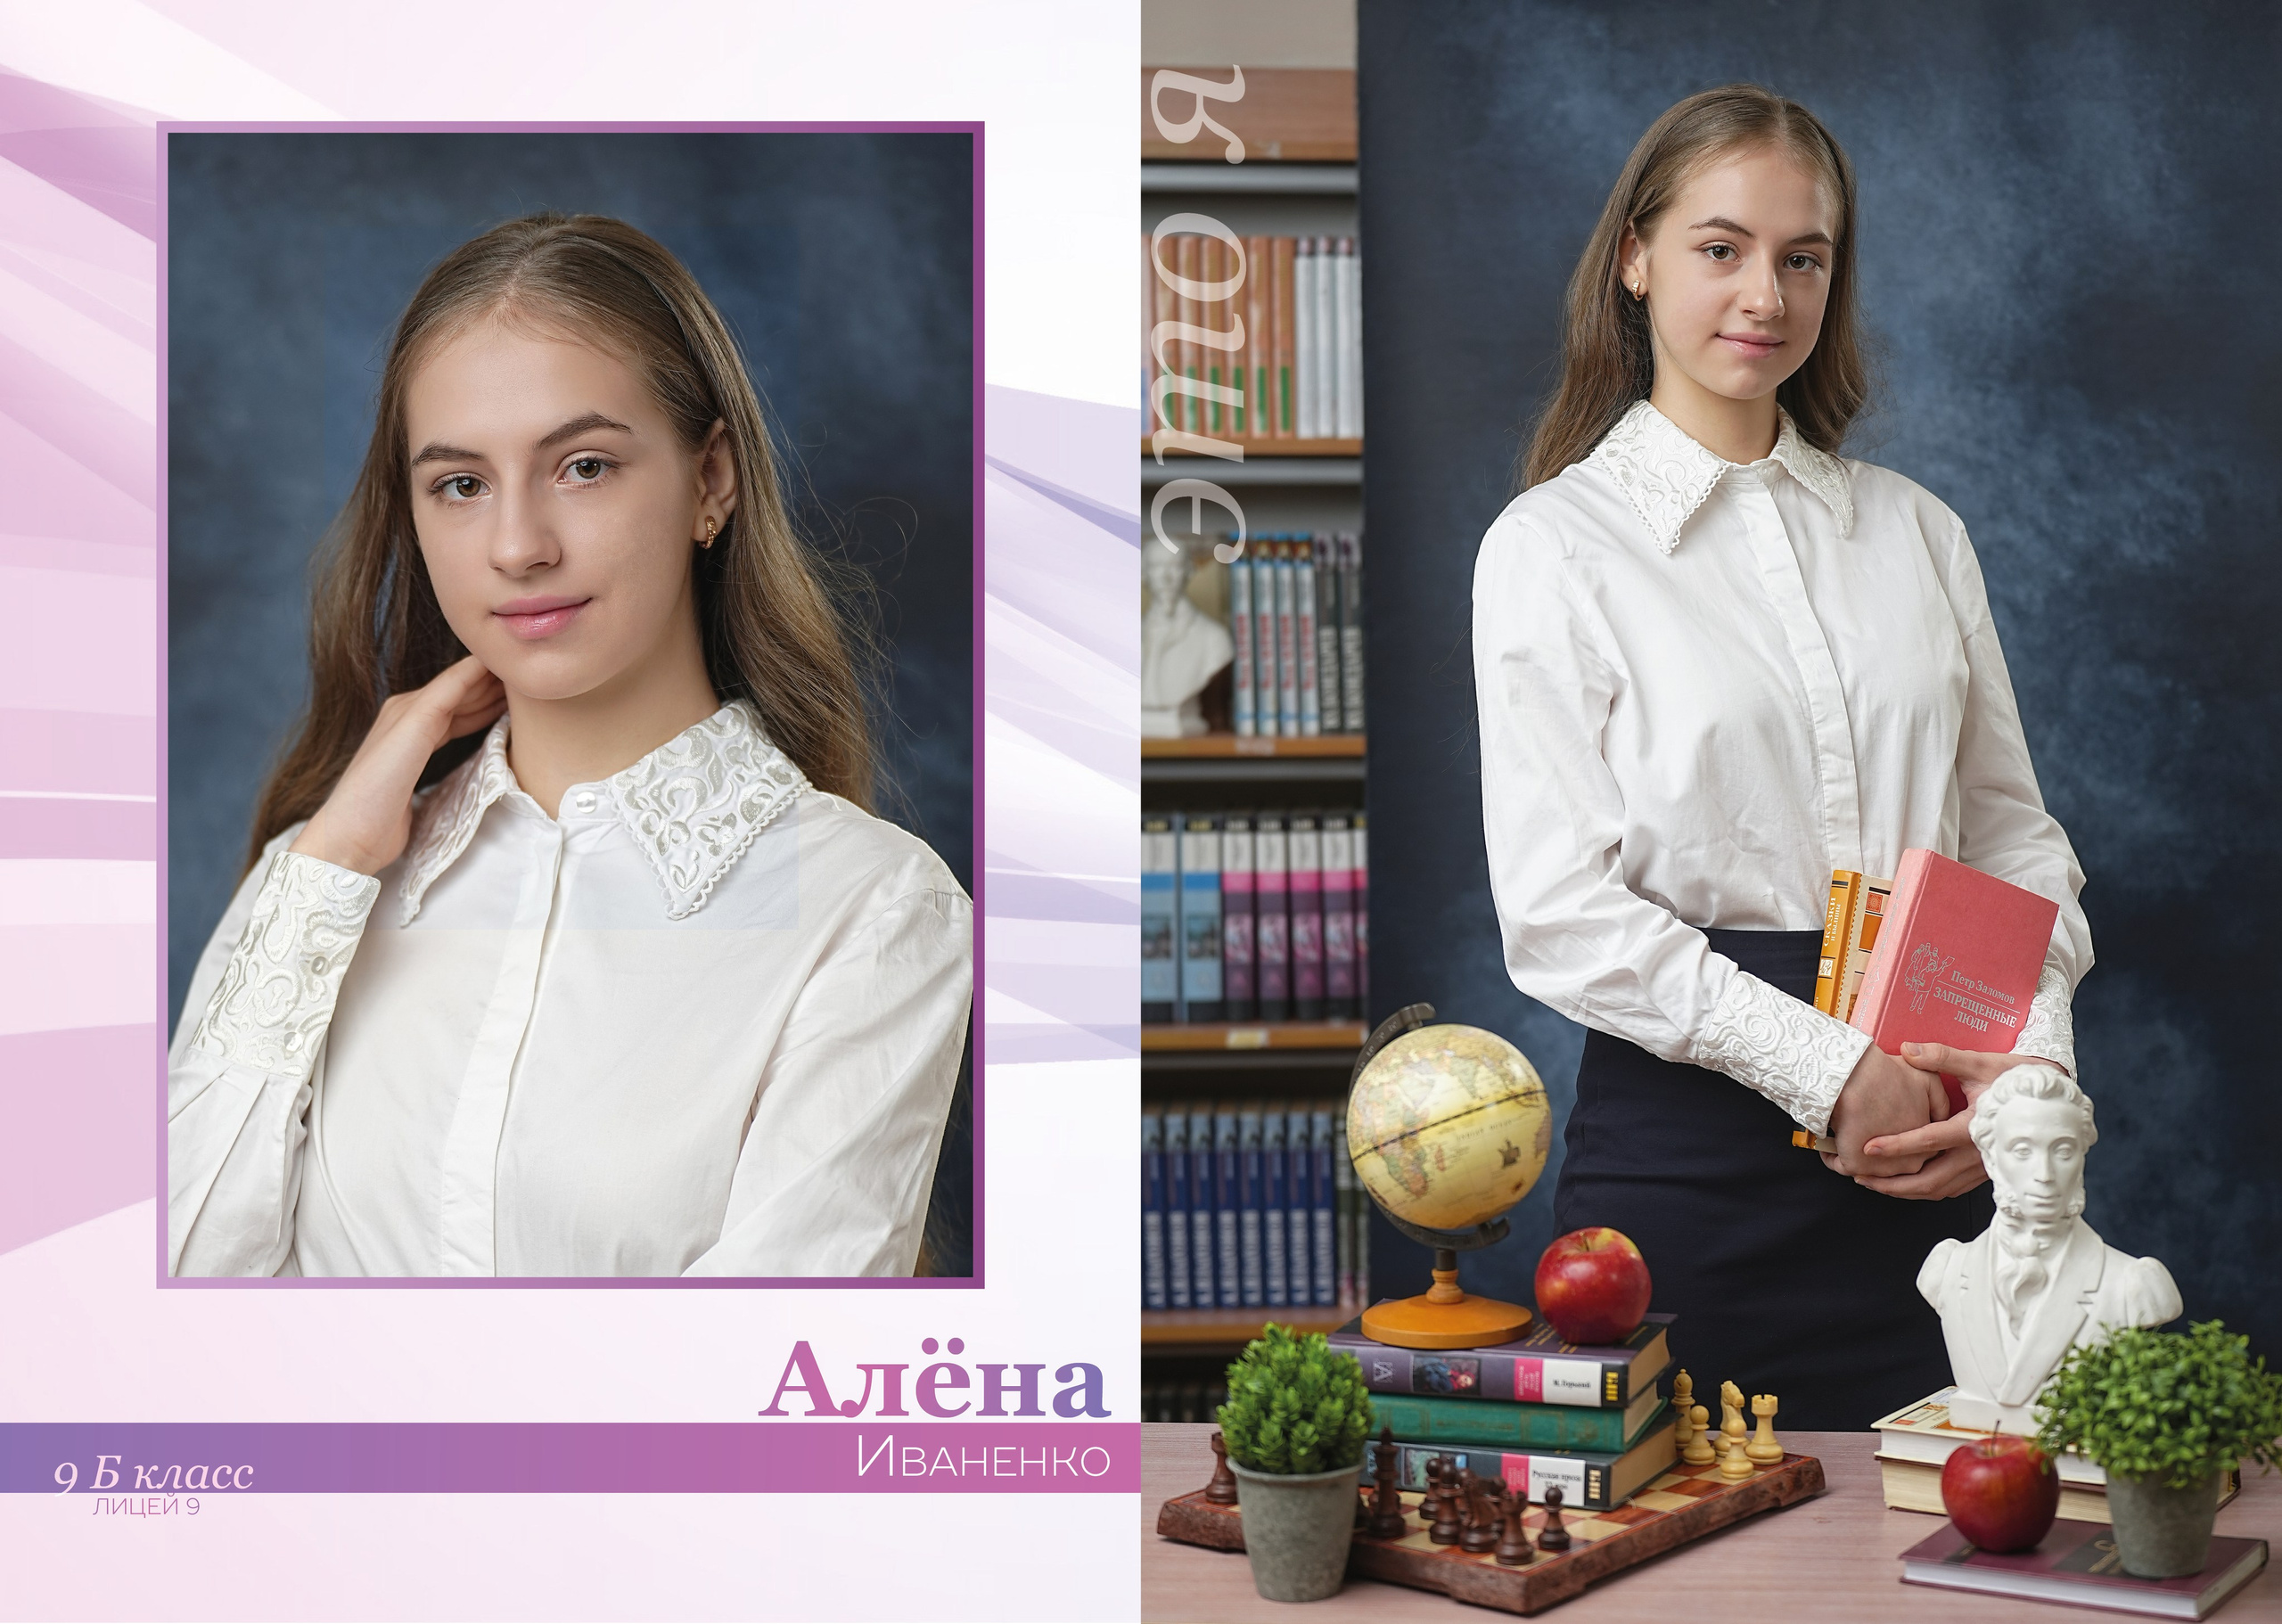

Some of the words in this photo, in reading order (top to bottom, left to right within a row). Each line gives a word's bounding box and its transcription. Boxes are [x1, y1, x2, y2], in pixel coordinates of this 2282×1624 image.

[1824, 897, 1836, 947] СКАЗКИ
[1950, 970, 1975, 991] Петр
[1975, 980, 2015, 1005] Заломов
[1933, 986, 2018, 1029] ЗАПРЕЩЕННЫЕ
[1953, 1010, 1990, 1033] ЛЮДИ
